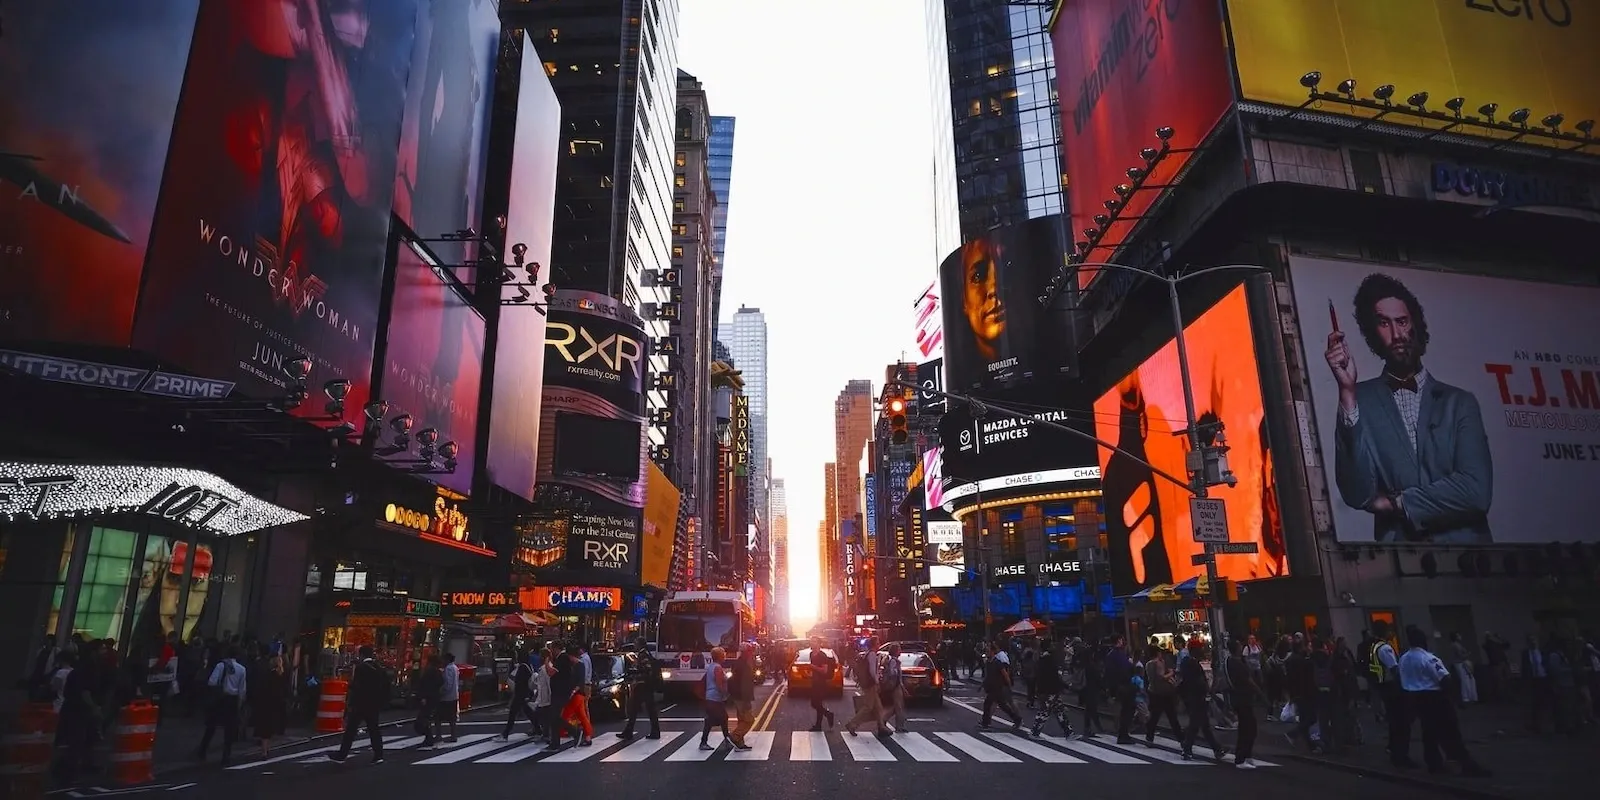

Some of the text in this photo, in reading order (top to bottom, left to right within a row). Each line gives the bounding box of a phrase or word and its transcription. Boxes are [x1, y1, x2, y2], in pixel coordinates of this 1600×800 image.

[200, 217, 360, 342] WONDER WOMAN
[205, 293, 219, 306] THE
[224, 303, 251, 324] FUTURE
[253, 320, 263, 330] OF
[265, 328, 293, 347] JUSTICE
[252, 342, 289, 371] JUN
[545, 321, 640, 380] RXR
[1514, 350, 1529, 361] AN
[1534, 352, 1561, 363] HBO
[567, 364, 621, 382] rxrrealty.com
[661, 271, 677, 460] CHAMPS
[988, 356, 1019, 372] EQUALITY.
[154, 376, 226, 398] PRIME
[392, 360, 438, 403] WONDER
[1485, 363, 1600, 411] T.J. M
[737, 396, 748, 464] MADAME
[983, 410, 1068, 433] MAZDA CAPITAL
[984, 427, 1029, 445] SERVICES
[1543, 443, 1586, 461] JUNE
[1005, 475, 1033, 490] CHASE
[141, 481, 240, 527] LOFT
[1197, 501, 1219, 510] BUSES
[608, 516, 622, 526] New
[1200, 511, 1217, 519] ONLY
[572, 525, 636, 542] for the 21st Century
[913, 508, 922, 545] VICTORY
[584, 540, 629, 563] RXR
[593, 561, 622, 569] REALTY
[845, 544, 854, 596] REGAL
[995, 565, 1026, 577] CHASE
[1039, 561, 1081, 574] CHASE
[452, 592, 485, 605] KNOW
[548, 590, 613, 607] CHAMPS
[1178, 610, 1201, 622] SODA
